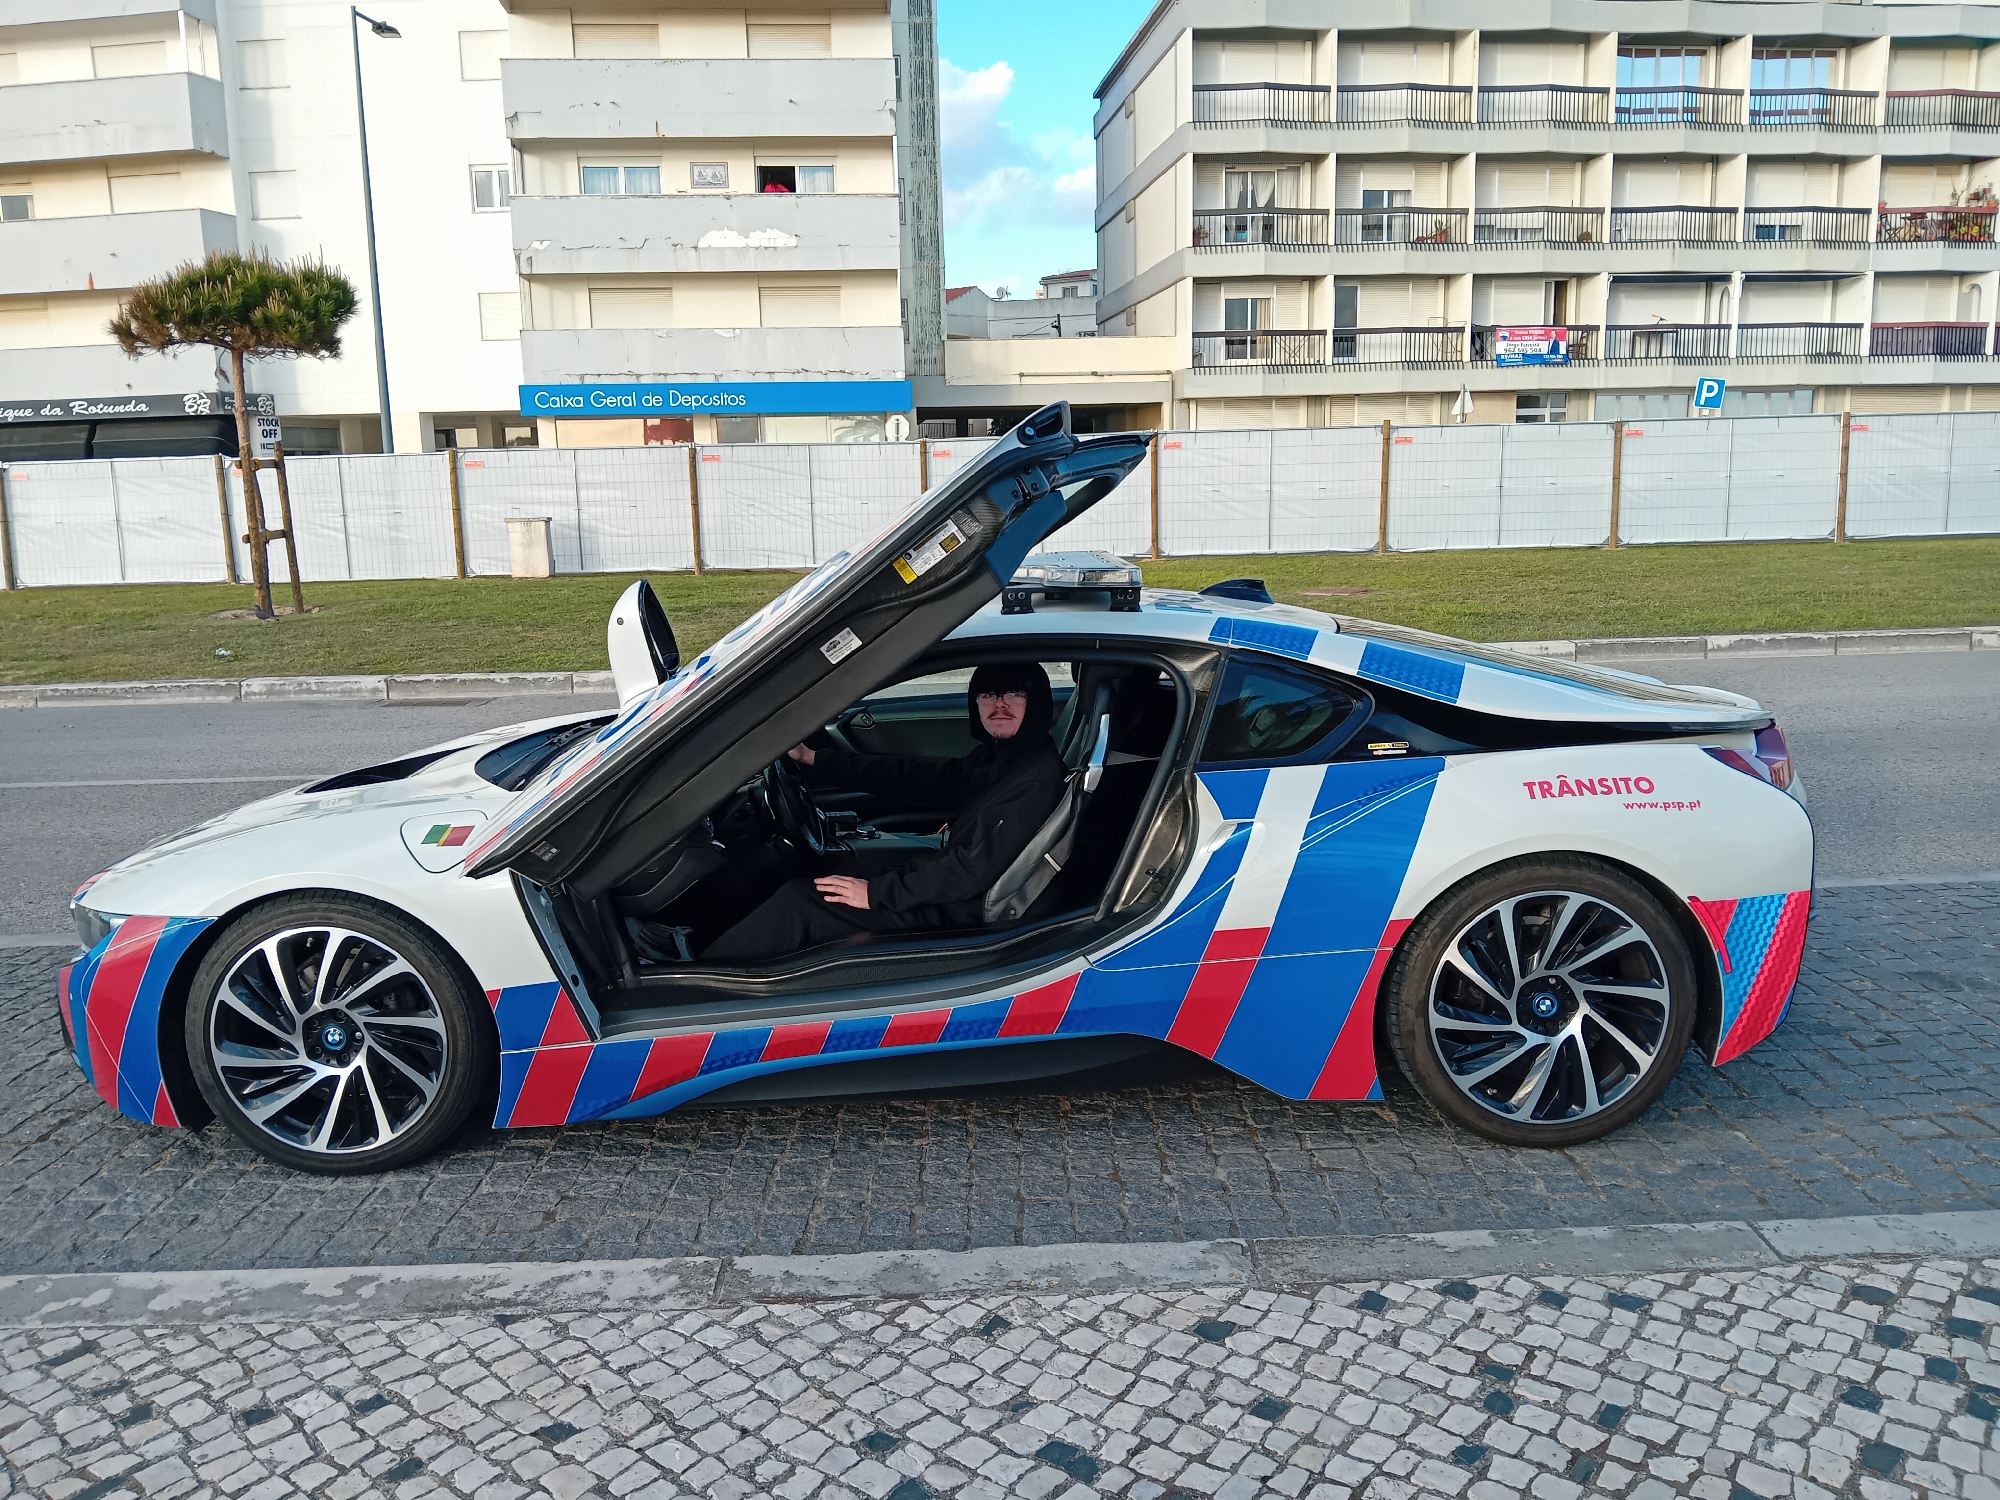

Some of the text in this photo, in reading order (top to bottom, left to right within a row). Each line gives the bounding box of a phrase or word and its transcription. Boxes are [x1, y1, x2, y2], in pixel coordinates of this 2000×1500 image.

[534, 389, 747, 410] Caixa Geral de Depositos
[1700, 380, 1719, 405] P
[40, 403, 64, 415] da
[68, 400, 150, 416] Rotunda
[257, 417, 280, 427] STOCK
[261, 428, 278, 439] OFF
[1522, 774, 1655, 800] TRÂNSITO
[1622, 799, 1701, 812] www.psp.pt
